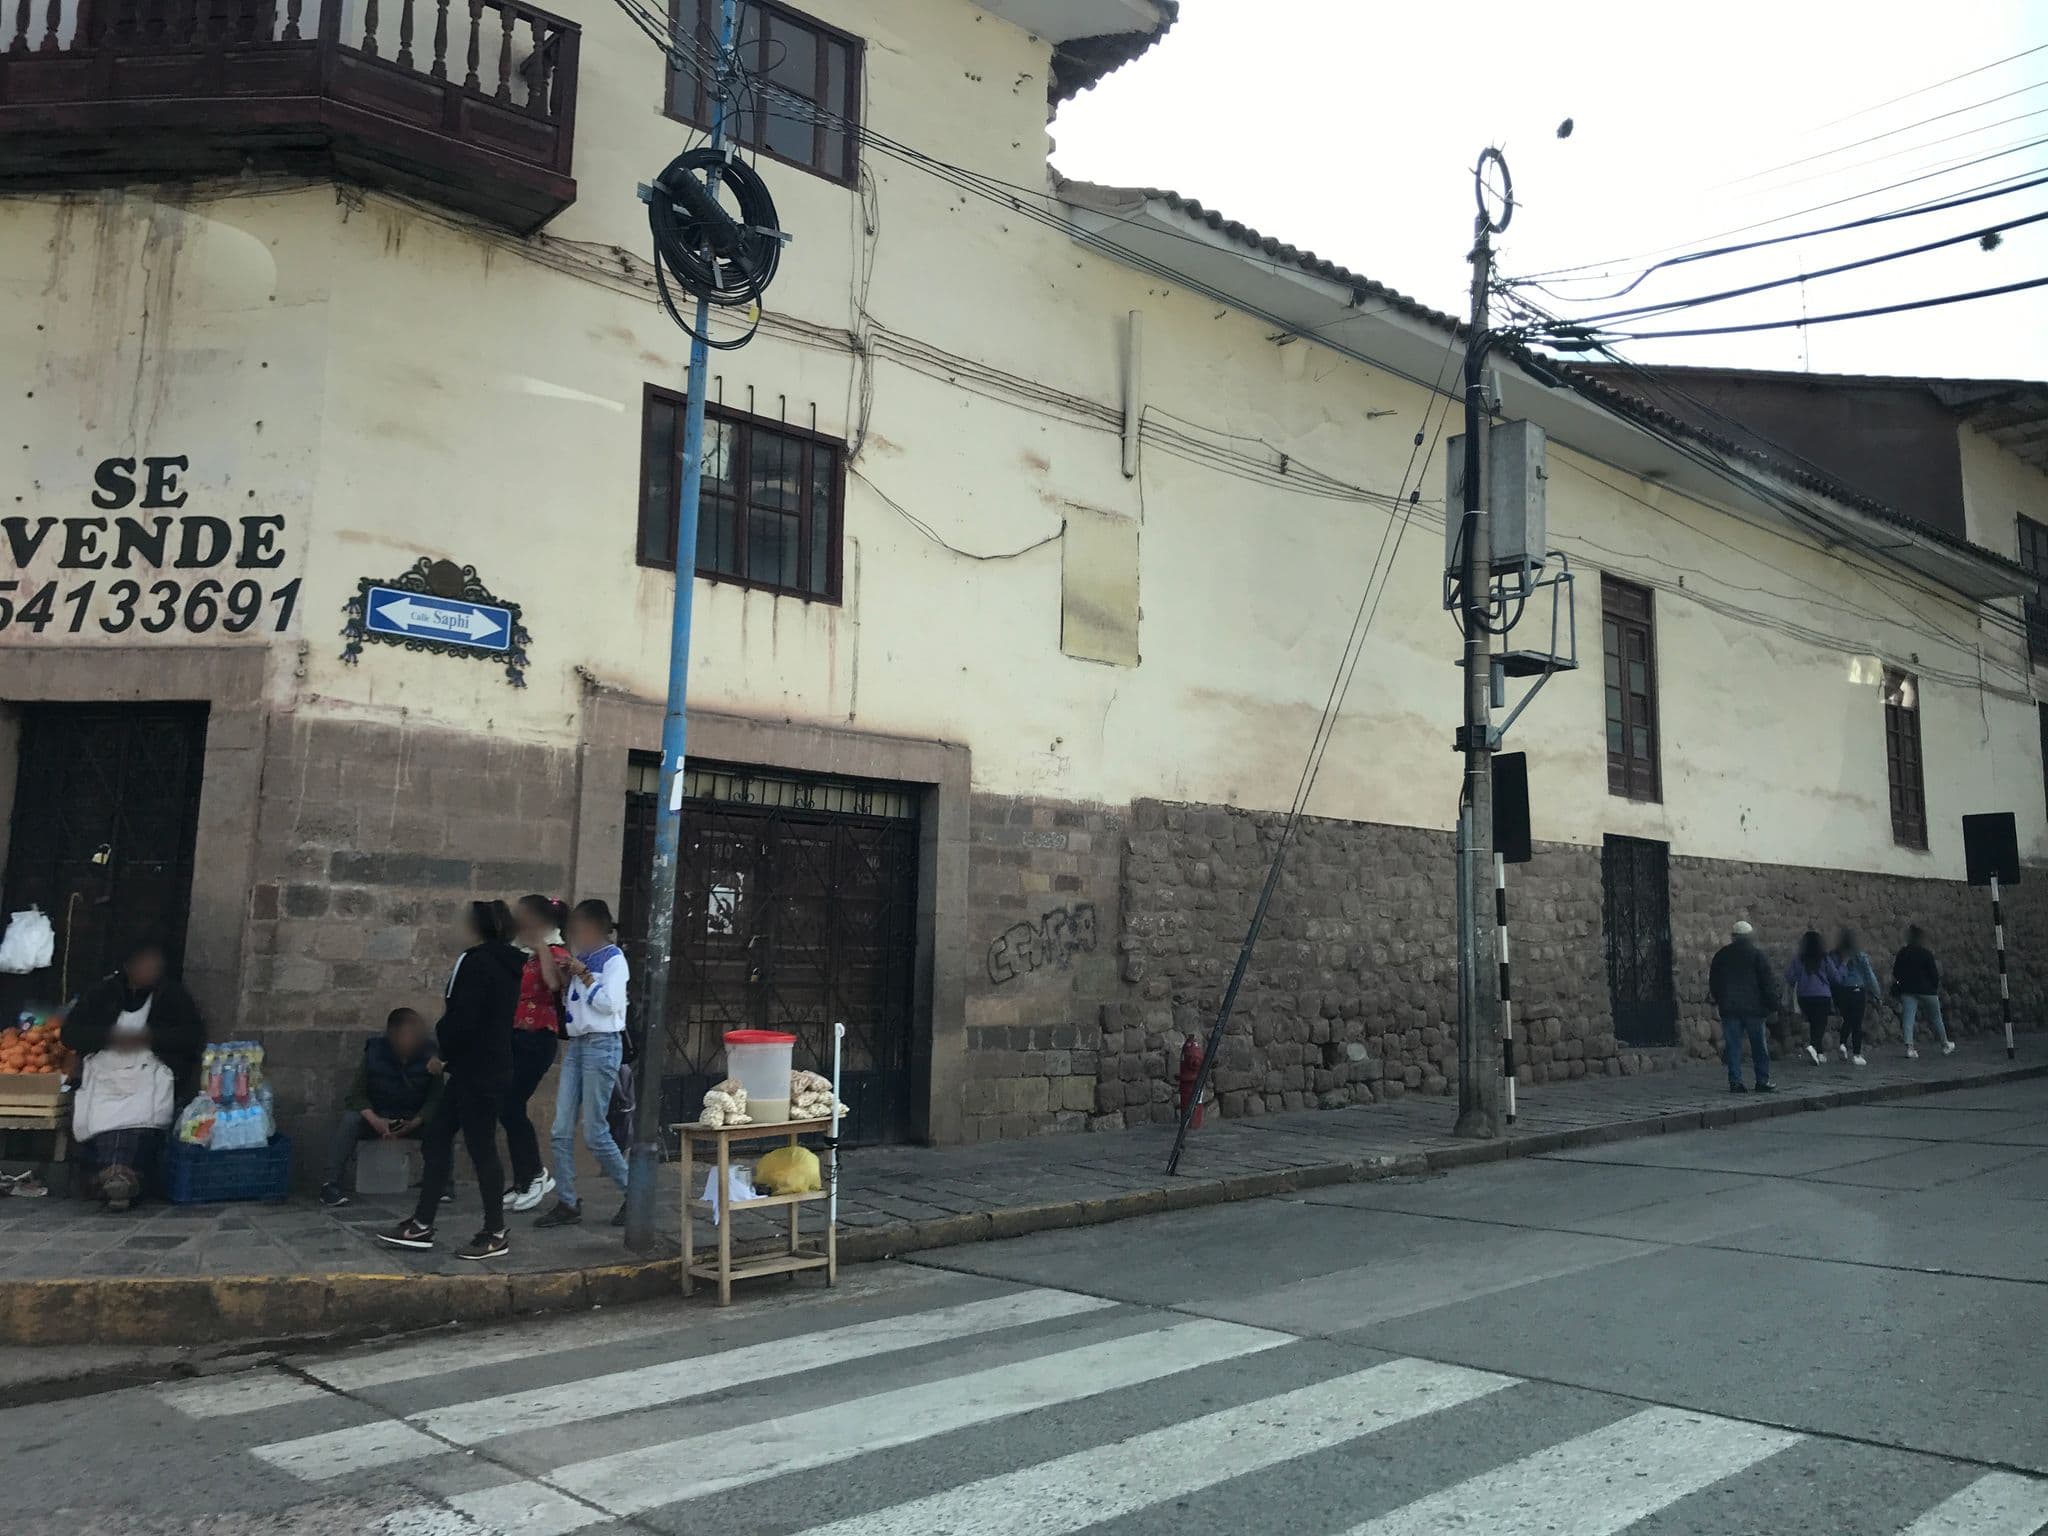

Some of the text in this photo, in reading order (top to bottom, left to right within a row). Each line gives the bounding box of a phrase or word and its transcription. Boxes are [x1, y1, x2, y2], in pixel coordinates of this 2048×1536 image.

[91, 455, 189, 509] SE
[1, 514, 286, 570] VENDE
[433, 610, 470, 629] Saphi
